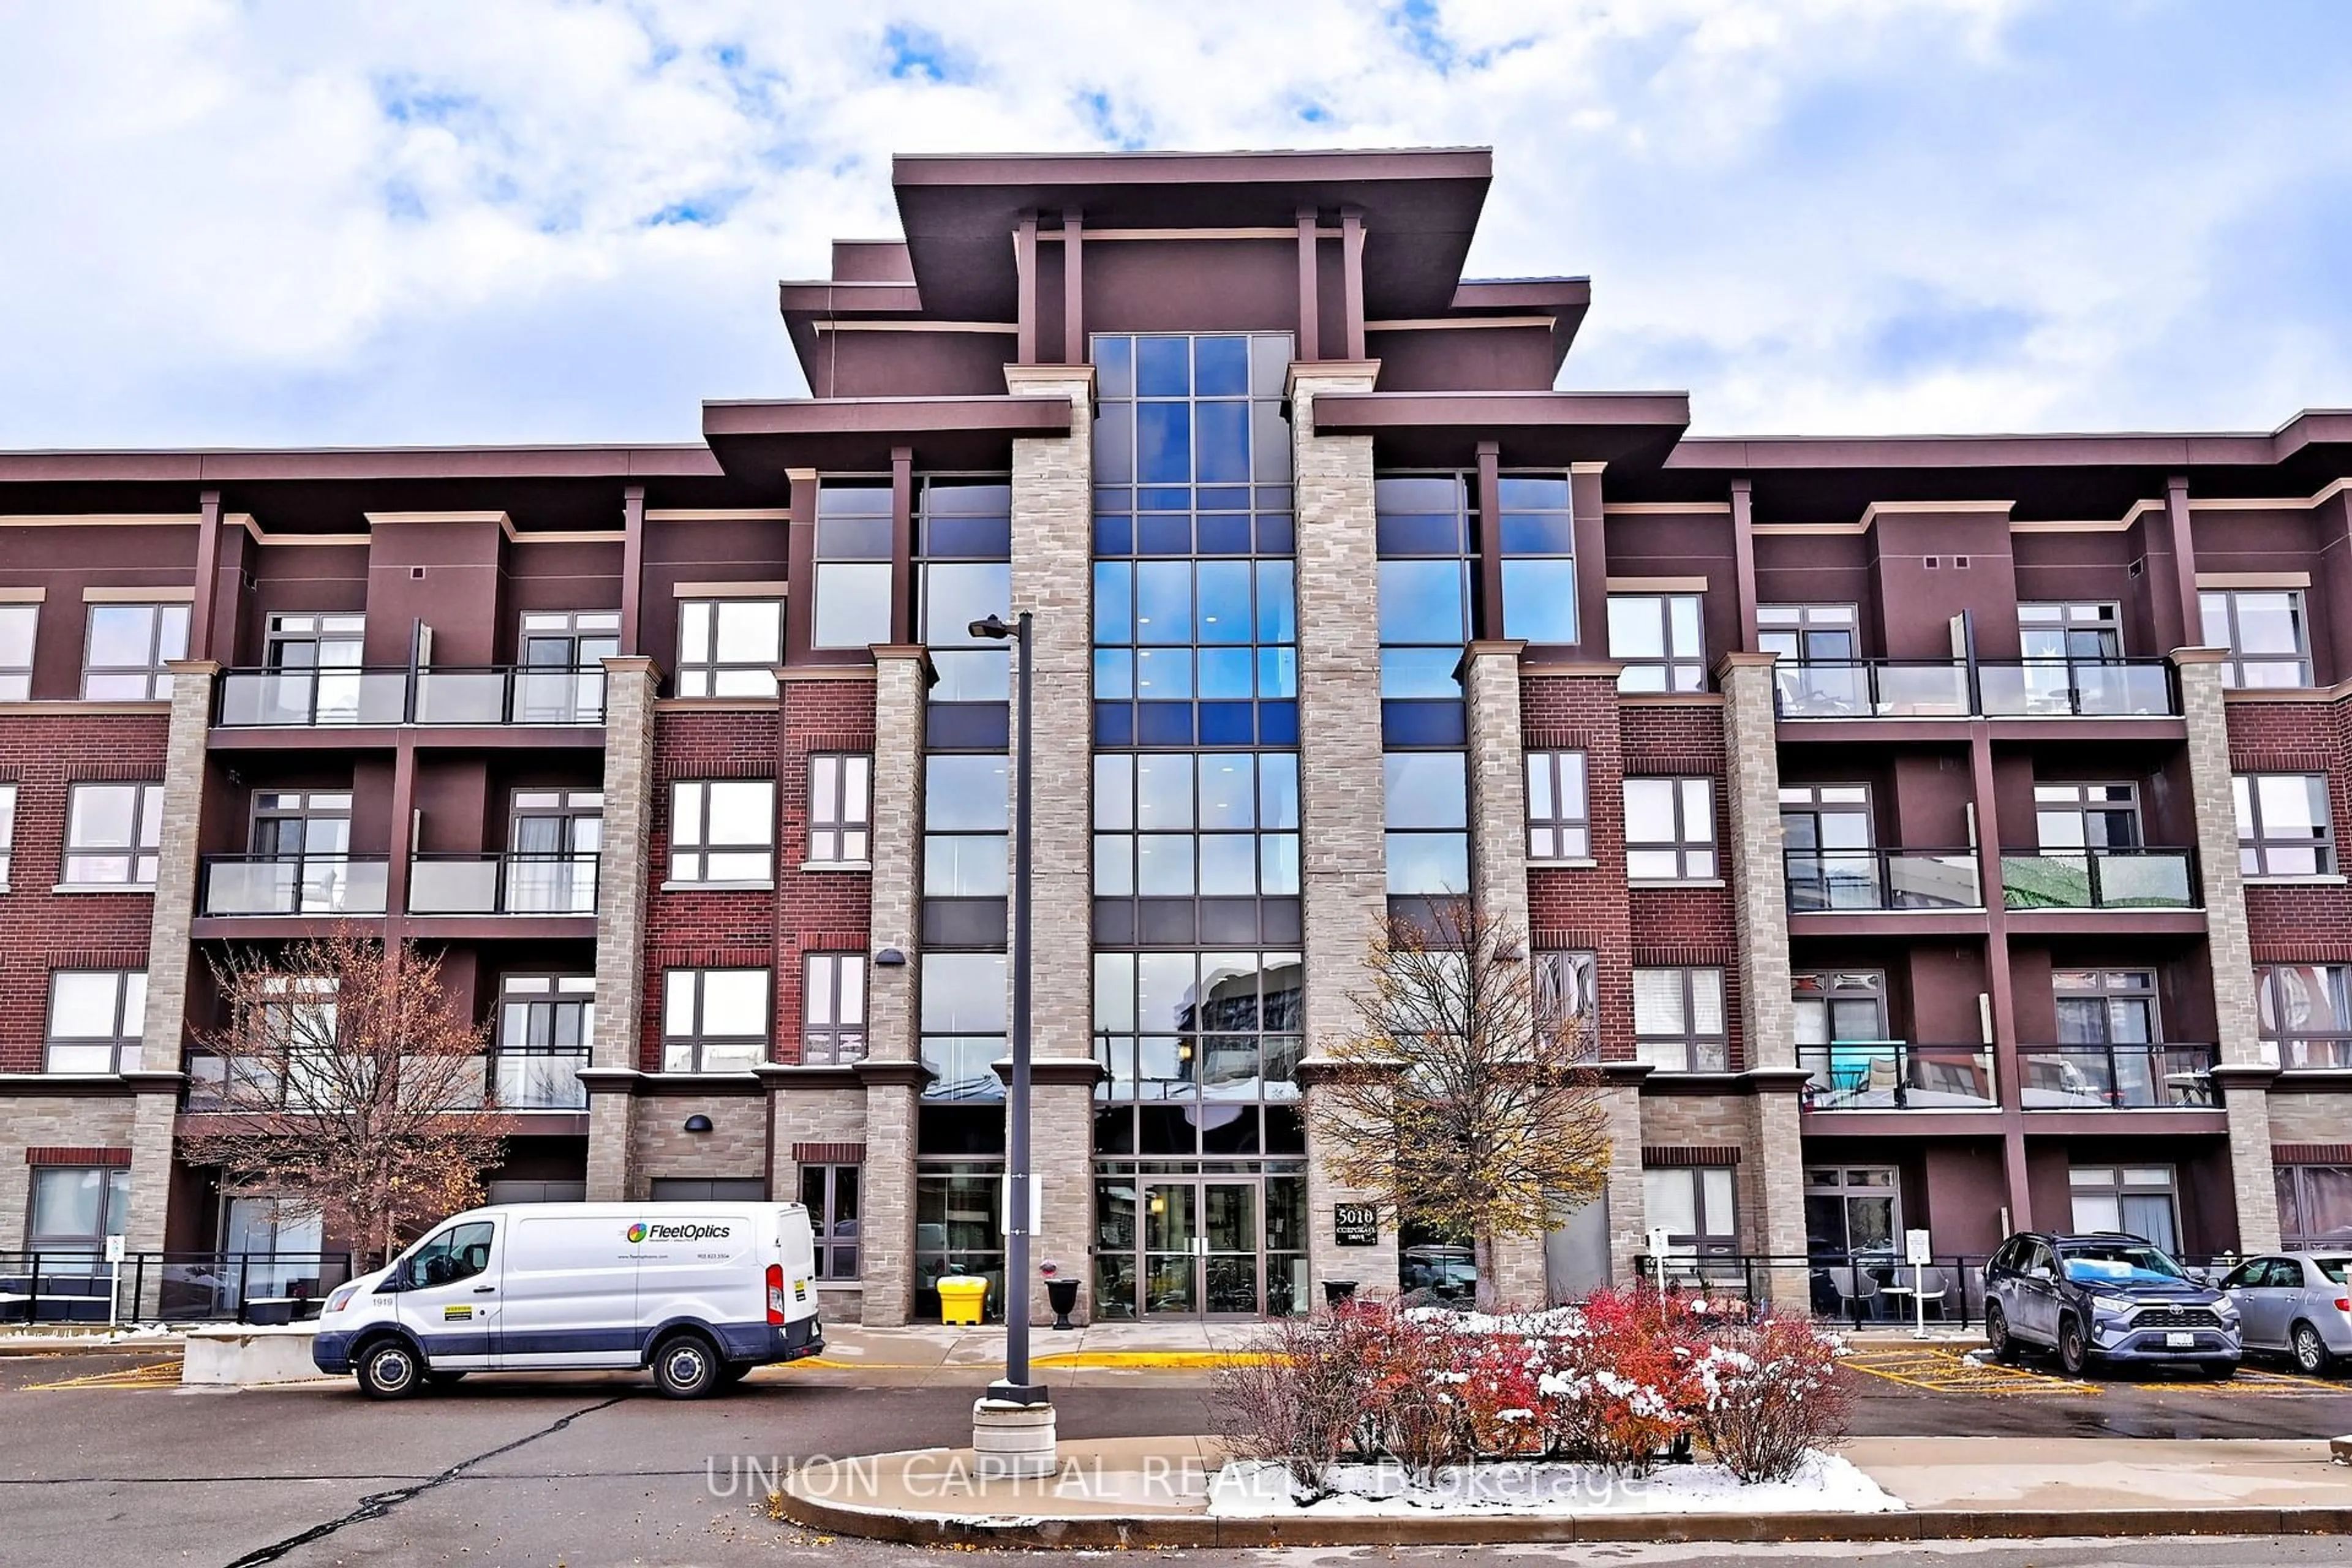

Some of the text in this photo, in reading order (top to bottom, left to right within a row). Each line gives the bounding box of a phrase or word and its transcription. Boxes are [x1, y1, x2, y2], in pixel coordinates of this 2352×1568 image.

[1338, 1208, 1373, 1224] 5010
[649, 1224, 730, 1241] FleetOptics
[373, 1298, 393, 1307] 1919
